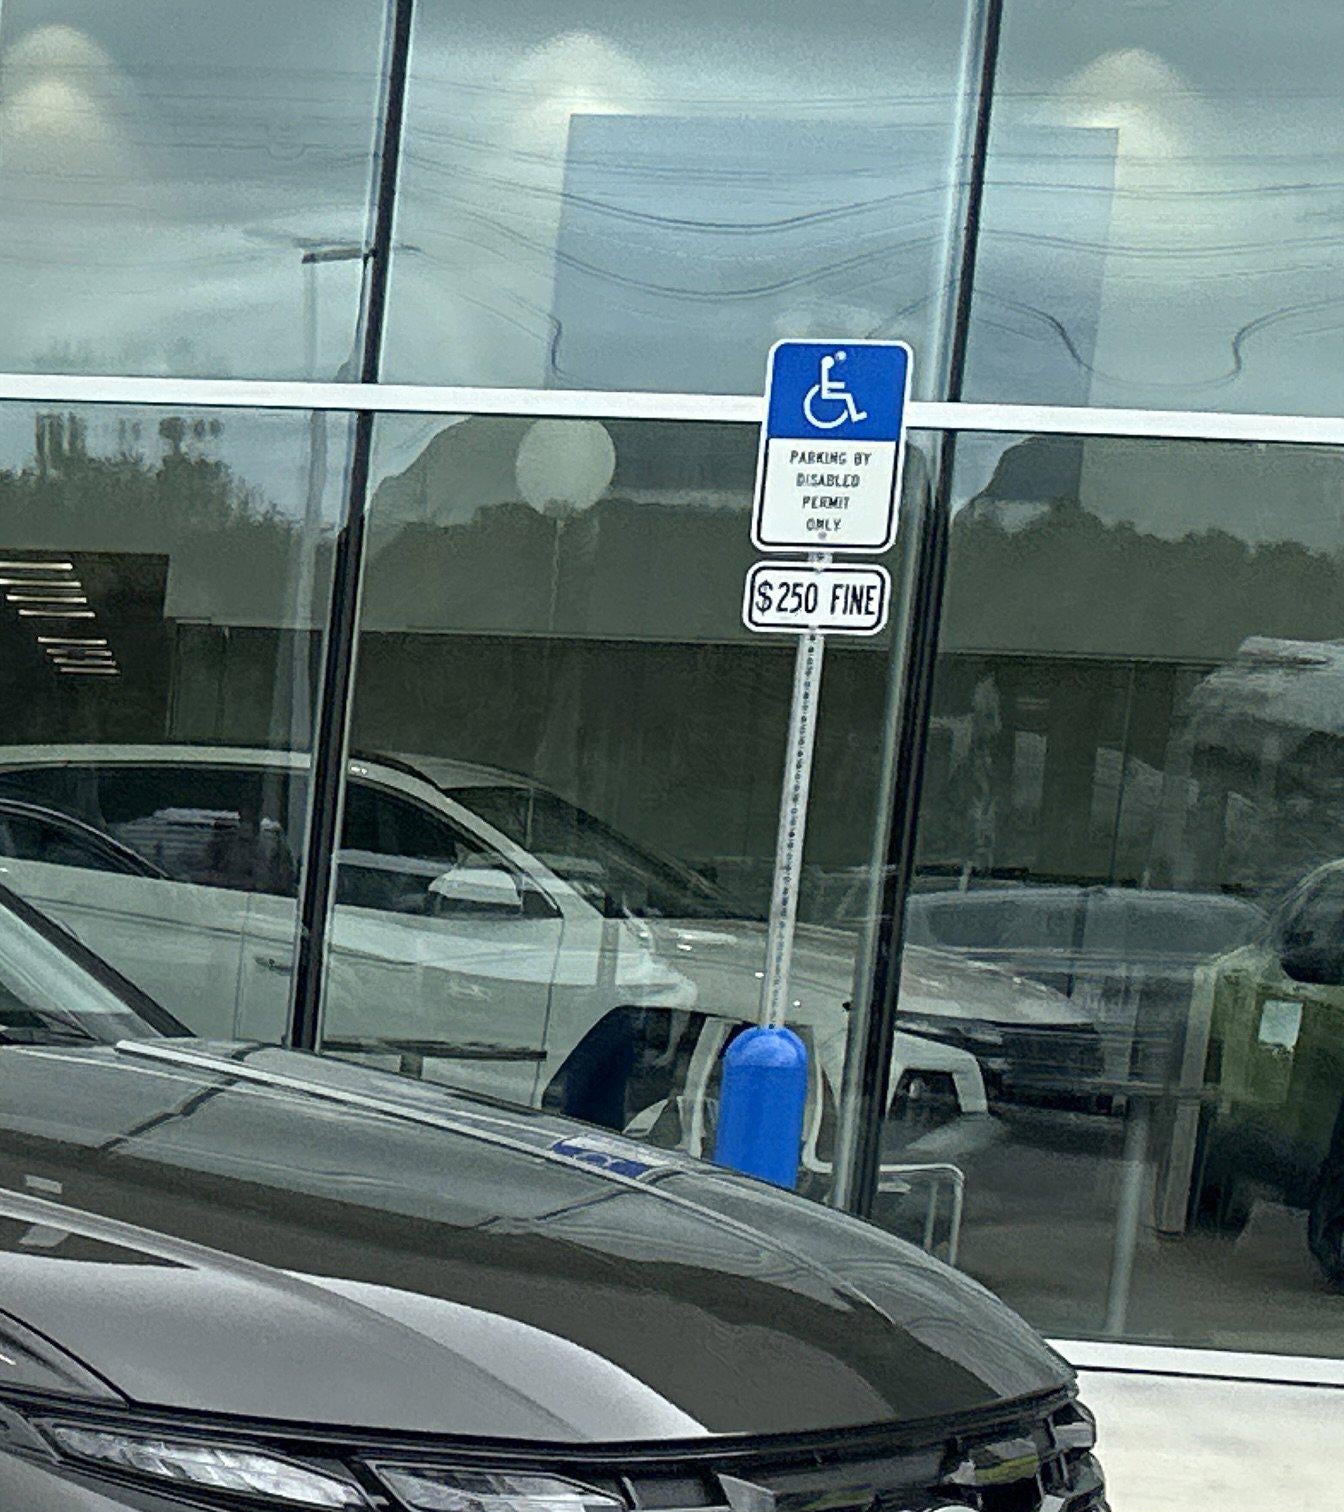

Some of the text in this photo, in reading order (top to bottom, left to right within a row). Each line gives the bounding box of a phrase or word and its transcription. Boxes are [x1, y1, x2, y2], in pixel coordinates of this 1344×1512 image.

[789, 449, 872, 466] PARKING BY
[795, 472, 861, 488] DISABLED
[802, 495, 851, 510] PERMIT
[806, 517, 842, 532] ONLY
[755, 579, 878, 617] $250 FINE
